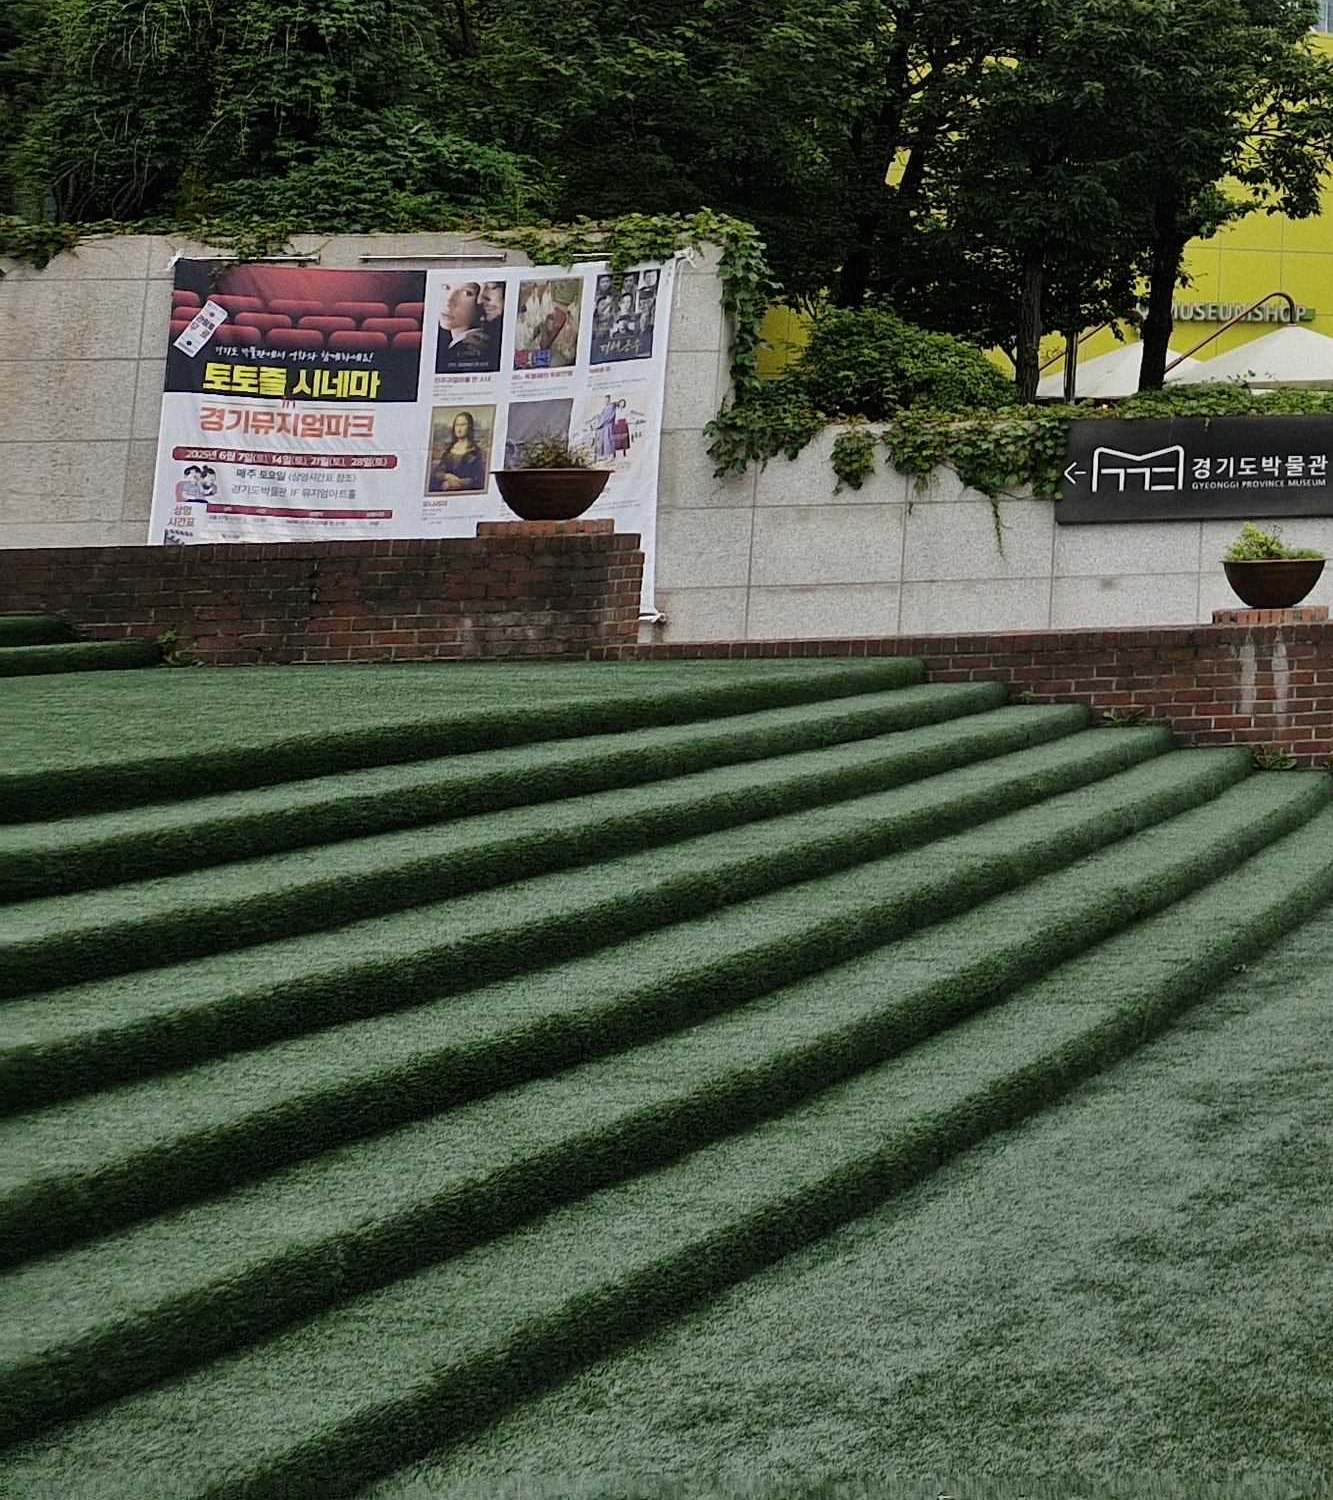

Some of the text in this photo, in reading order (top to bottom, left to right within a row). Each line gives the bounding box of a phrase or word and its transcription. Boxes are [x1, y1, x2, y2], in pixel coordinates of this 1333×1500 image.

[202, 363, 381, 399] 토토즐 시네마
[281, 396, 296, 408] in
[200, 407, 375, 439] 경기뮤지엄파크
[185, 449, 217, 461] 2025년
[219, 451, 236, 462] 6월
[1192, 455, 1329, 480] 경기도박물관
[236, 470, 257, 480] 매주
[259, 471, 286, 482] 토요일
[1192, 478, 1327, 490] GYEONGGI PROVINCE MUSEUM
[231, 485, 288, 498] 경기도박물관
[174, 505, 192, 516] 상영
[167, 516, 196, 528] 시간표
